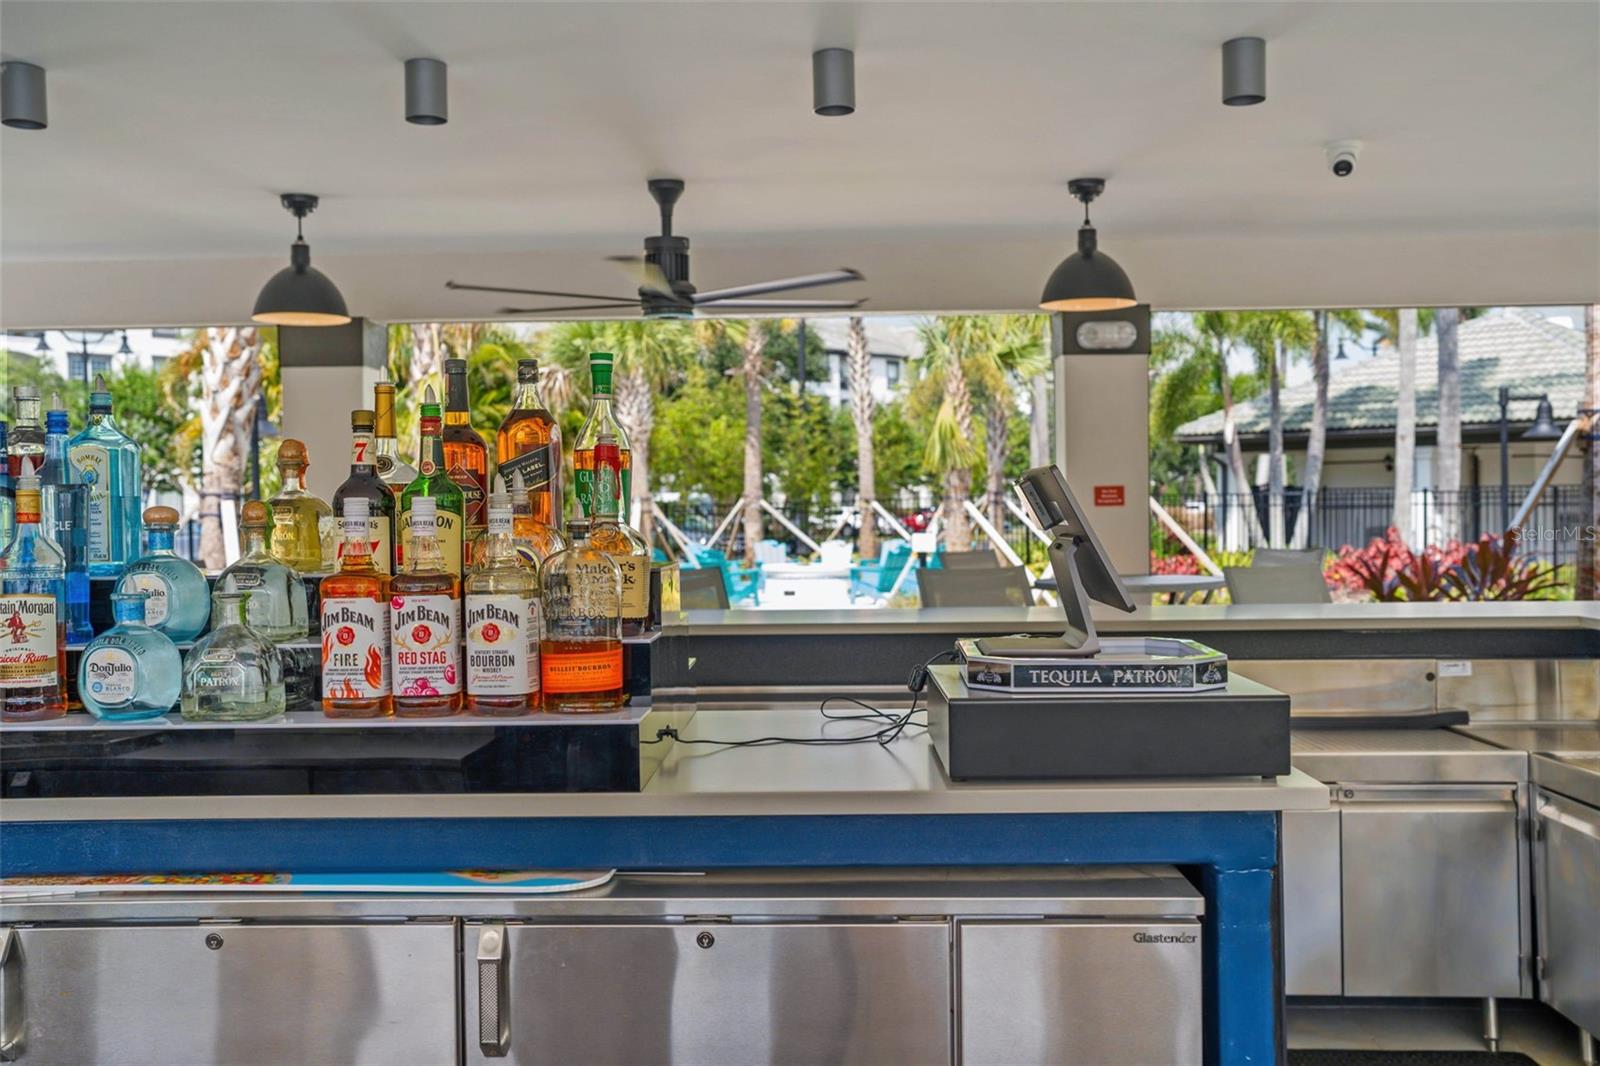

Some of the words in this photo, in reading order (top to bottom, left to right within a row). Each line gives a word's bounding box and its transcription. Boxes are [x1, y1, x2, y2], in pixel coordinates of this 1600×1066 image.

[353, 442, 368, 462] 7
[0, 600, 16, 614] tain
[17, 600, 55, 616] Morgan
[323, 612, 340, 632] JIM
[341, 607, 375, 632] BEAM
[395, 610, 416, 630] JIM
[417, 605, 450, 630] BEAM
[467, 608, 485, 629] JIM
[486, 603, 520, 629] BEAM
[23, 652, 48, 664] Rum
[334, 653, 358, 667] FIRE
[398, 651, 417, 665] RED
[420, 650, 446, 665] STAG
[470, 655, 515, 667] BOURBON
[90, 662, 110, 673] Don
[107, 662, 132, 676] Julio
[1029, 670, 1102, 686] TEQUILA
[1113, 666, 1178, 686] PATRÓN
[1133, 932, 1197, 944] Glastender
